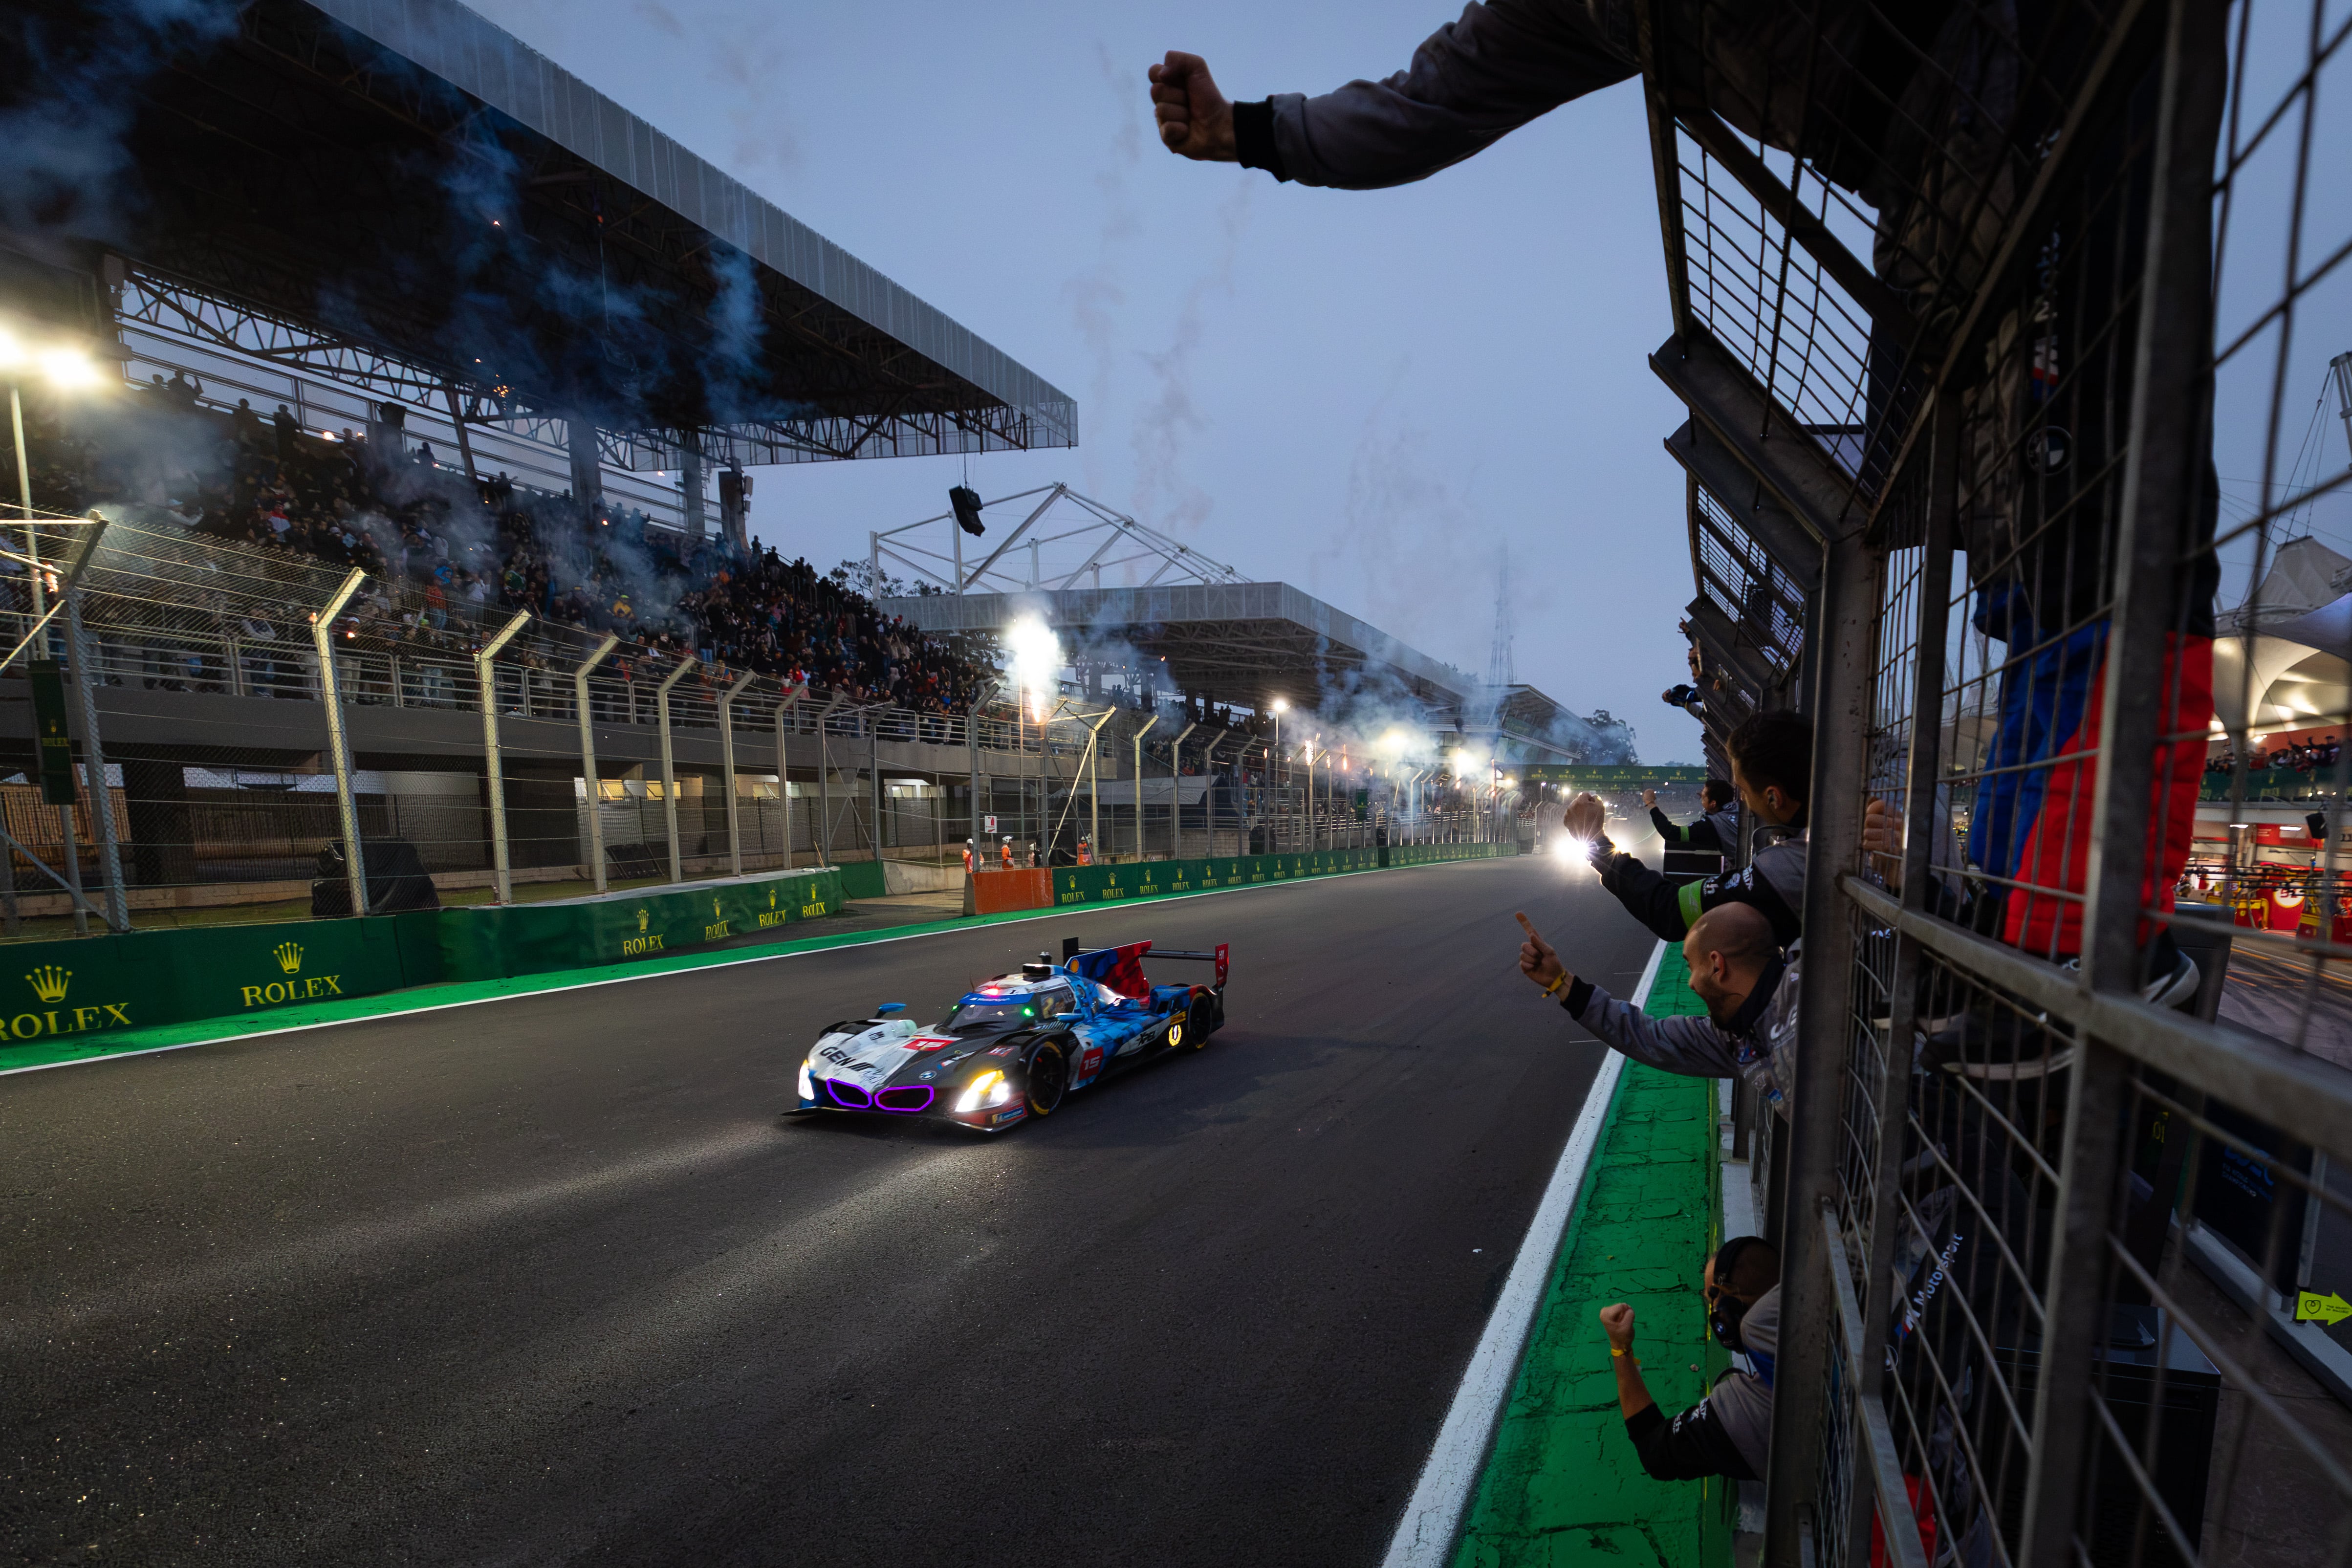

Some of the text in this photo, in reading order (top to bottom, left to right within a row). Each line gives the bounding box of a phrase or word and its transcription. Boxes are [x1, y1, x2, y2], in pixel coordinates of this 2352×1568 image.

[1103, 888, 1124, 899] ROLEX
[1140, 885, 1158, 894] ROLEX
[1062, 892, 1085, 904] ROLEX
[803, 902, 826, 917] ROLEX
[759, 910, 786, 928] ROLEX
[705, 920, 730, 940] ROLEX
[623, 934, 663, 956] ROLEX
[241, 975, 343, 1007] ROLEX
[1084, 1056, 1100, 1070] 15
